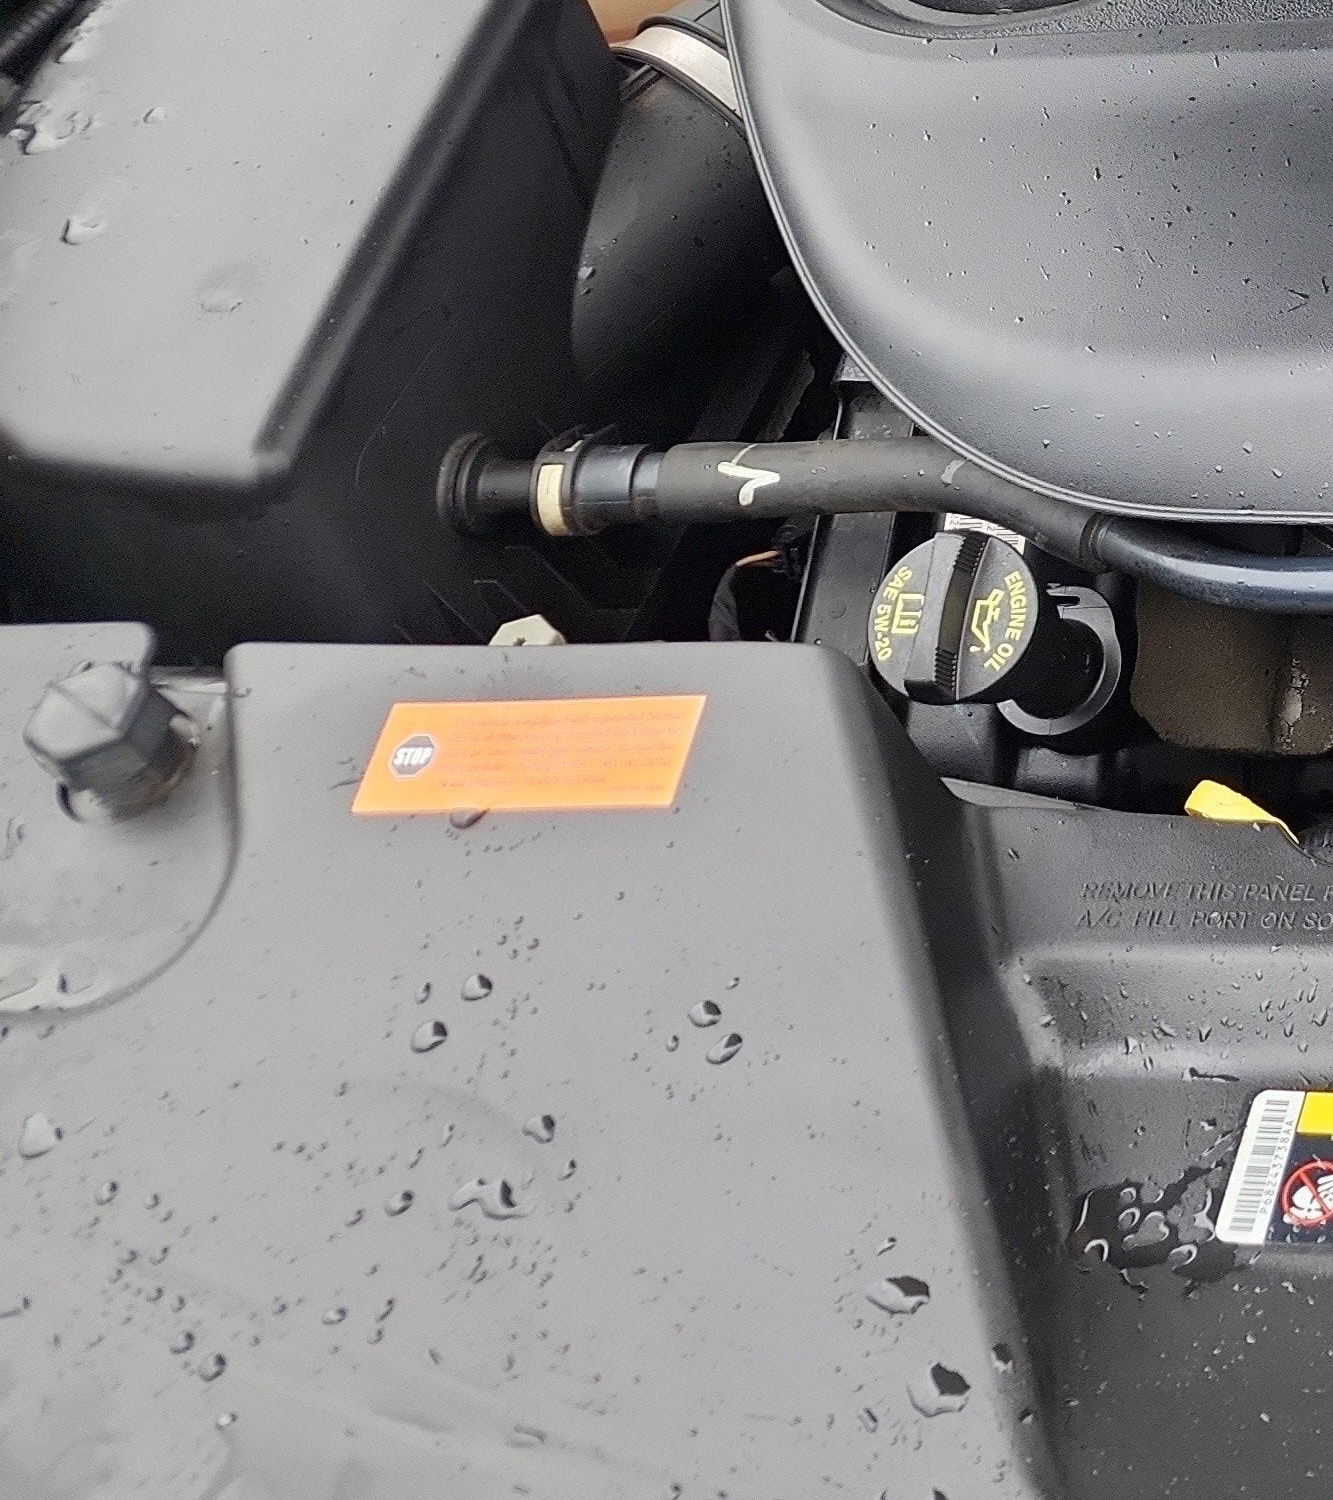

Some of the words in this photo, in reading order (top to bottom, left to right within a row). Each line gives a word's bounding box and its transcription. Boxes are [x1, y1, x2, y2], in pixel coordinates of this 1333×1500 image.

[882, 566, 913, 601] SAE
[1003, 570, 1028, 641] ENGINE
[873, 605, 893, 662] 5W-20
[983, 643, 1015, 672] OIL
[393, 746, 432, 766] STOP
[1081, 881, 1175, 899] REMOVE
[1187, 882, 1238, 901] THIS
[1242, 883, 1316, 901] PANEL
[1077, 909, 1124, 929] A/C
[1132, 910, 1179, 929] FILL
[1189, 911, 1252, 930] PORT
[1261, 912, 1297, 931] ON
